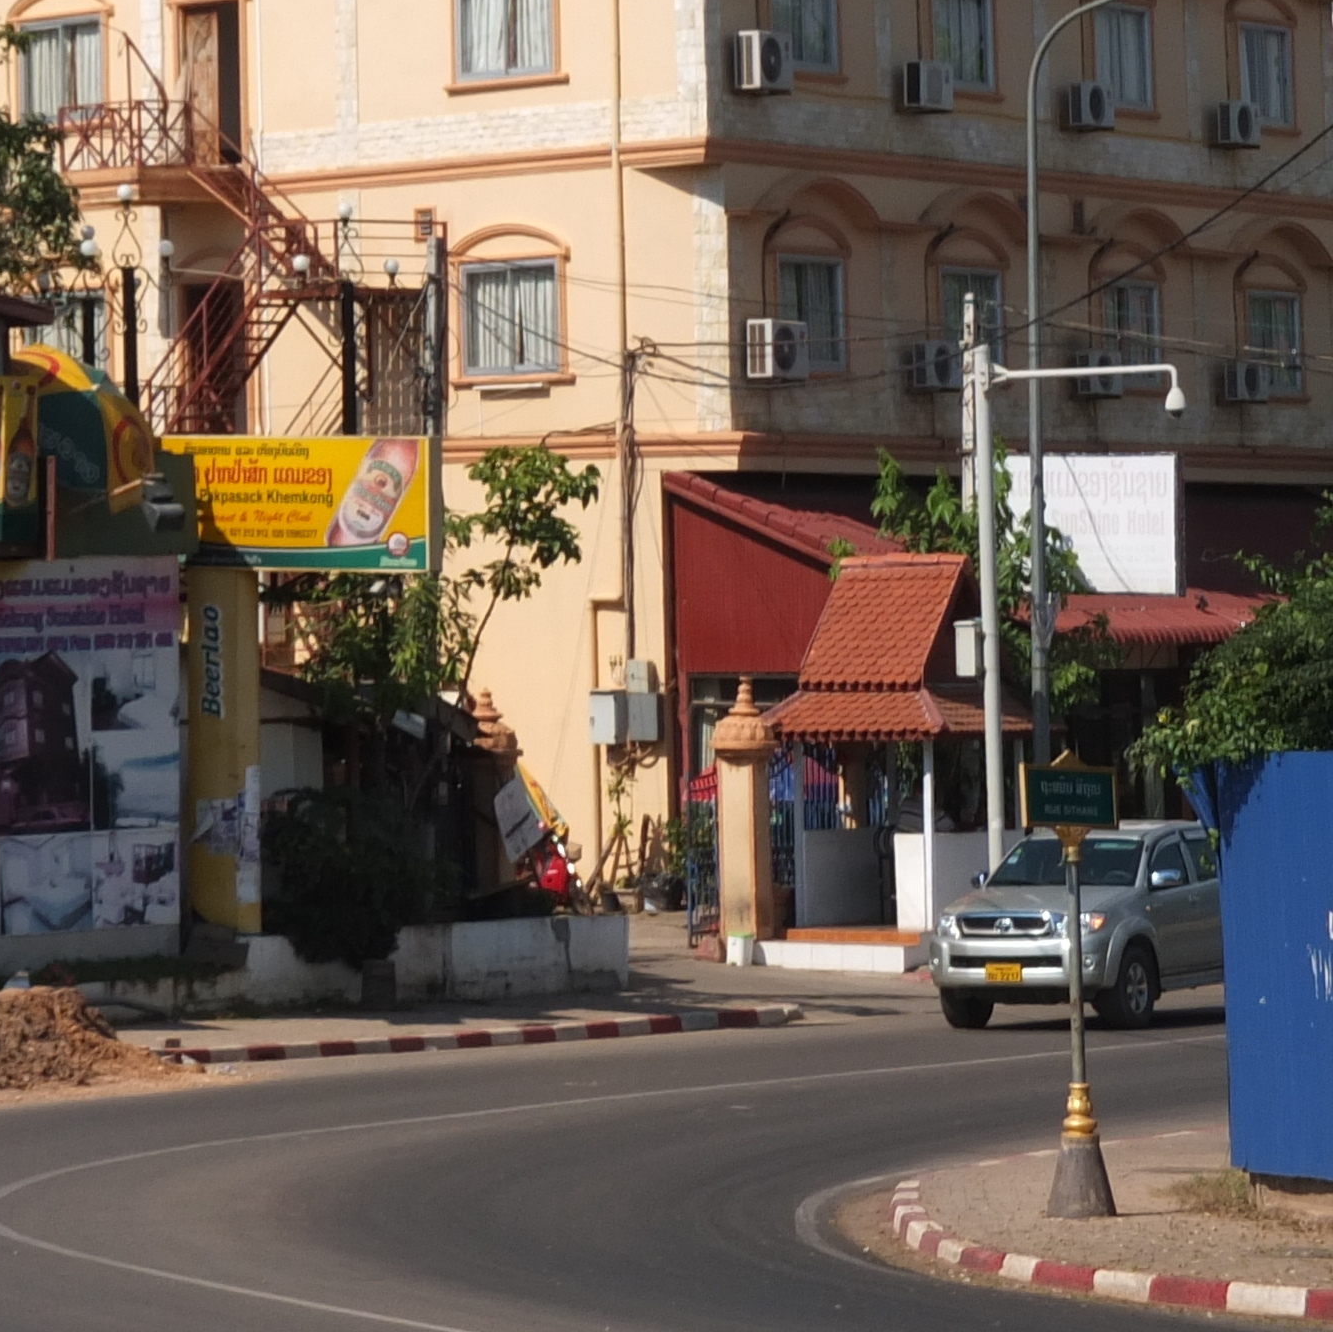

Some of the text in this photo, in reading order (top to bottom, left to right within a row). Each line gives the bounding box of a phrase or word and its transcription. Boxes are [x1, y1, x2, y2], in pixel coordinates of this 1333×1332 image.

[267, 489, 334, 508] Khemkong
[1128, 508, 1165, 535] Hotel
[200, 605, 223, 719] Beerlao
